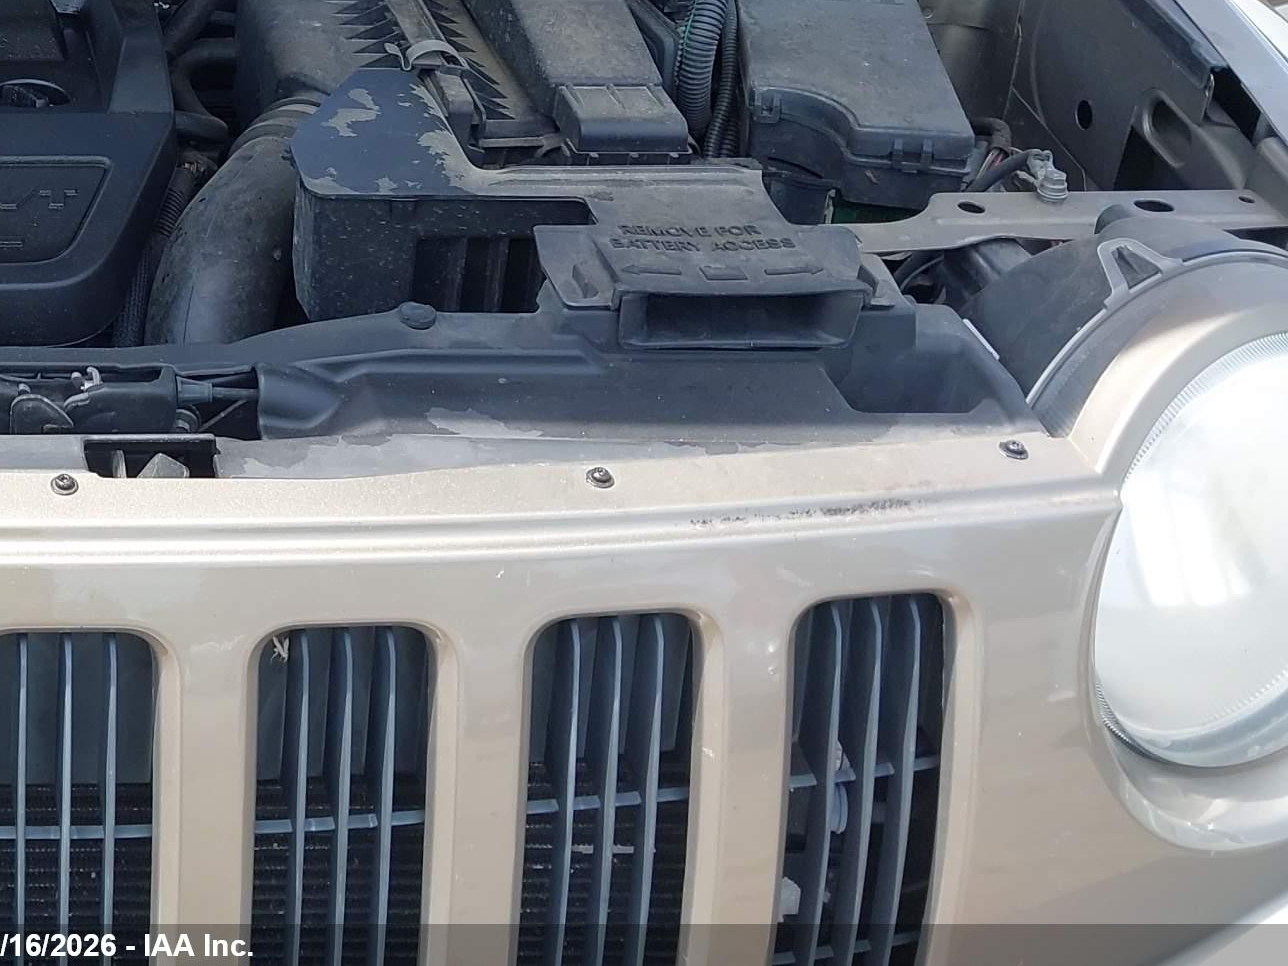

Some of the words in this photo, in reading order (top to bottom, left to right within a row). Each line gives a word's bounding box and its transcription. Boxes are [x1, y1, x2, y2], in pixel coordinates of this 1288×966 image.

[616, 224, 712, 238] REMOVE
[714, 224, 762, 237] FOR
[609, 237, 701, 252] BATTERY
[711, 237, 797, 252] ACCESS
